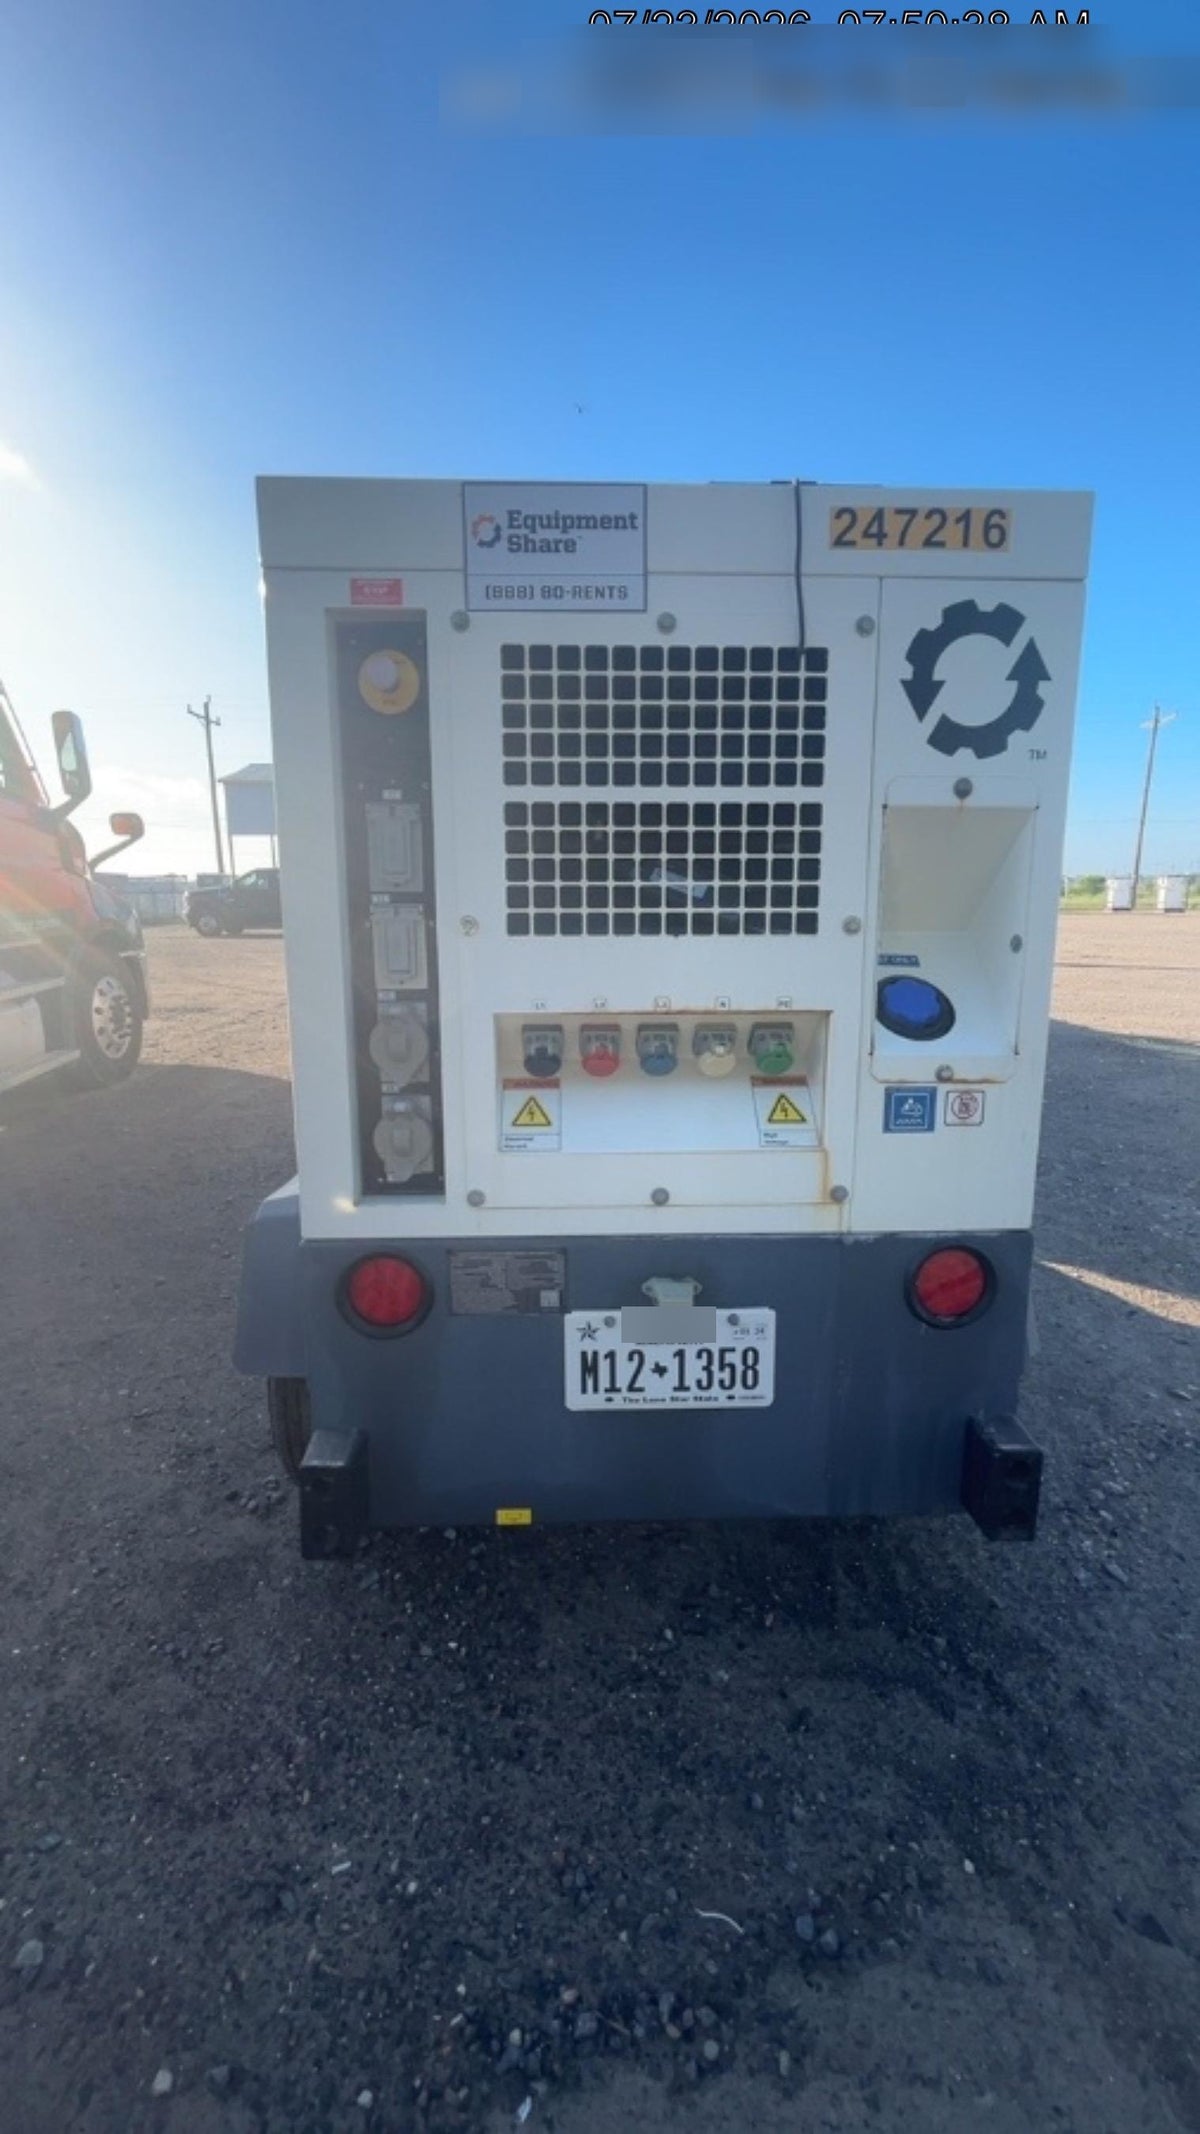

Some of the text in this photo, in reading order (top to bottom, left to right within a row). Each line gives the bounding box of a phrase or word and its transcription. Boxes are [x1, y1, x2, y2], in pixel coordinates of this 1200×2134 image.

[506, 509, 639, 534] Equipment
[832, 506, 1009, 549] 247216
[506, 533, 578, 553] Share
[580, 1346, 760, 1395] M12 1358
